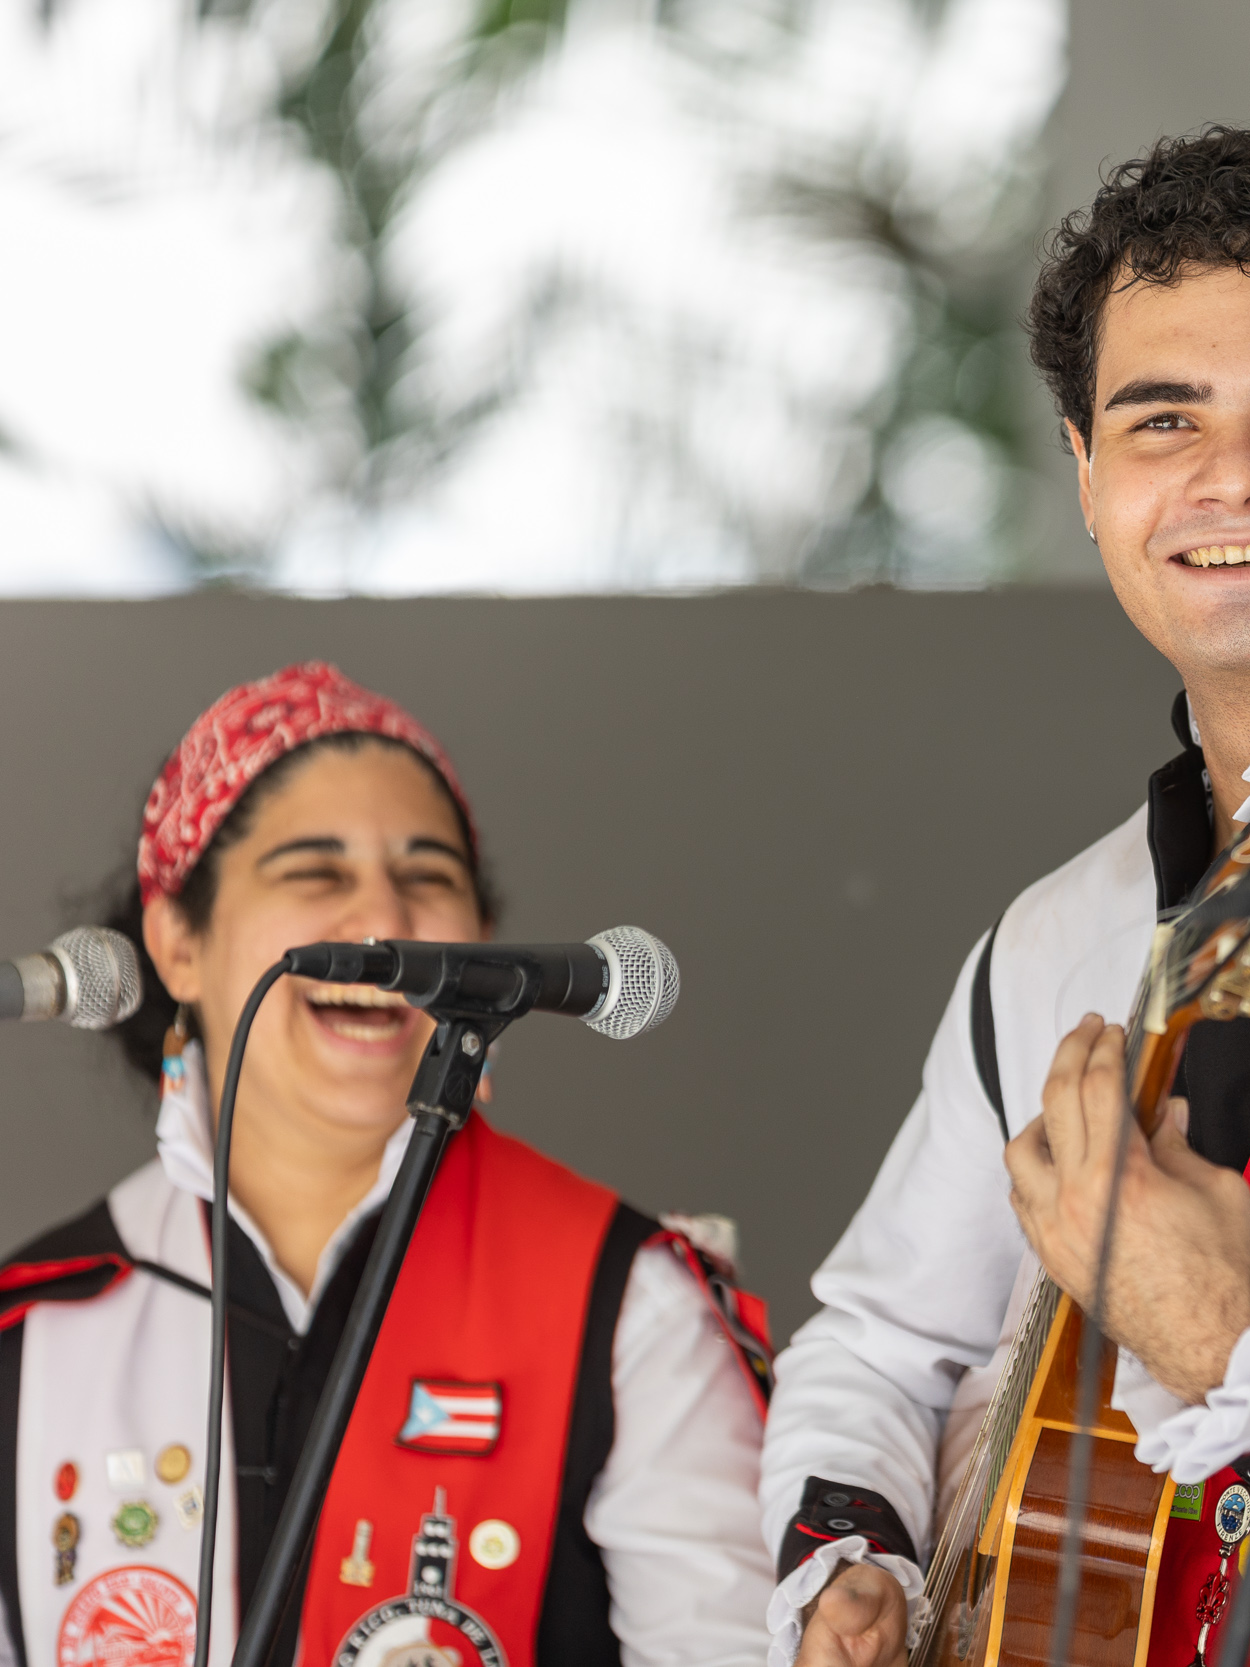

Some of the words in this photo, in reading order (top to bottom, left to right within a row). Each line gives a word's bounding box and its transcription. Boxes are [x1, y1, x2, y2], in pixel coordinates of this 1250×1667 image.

[1237, 1486, 1250, 1514] VECCHIO
[1216, 1522, 1243, 1542] FIRENZE
[405, 1598, 462, 1626] TUNA
[459, 1618, 486, 1646] DE
